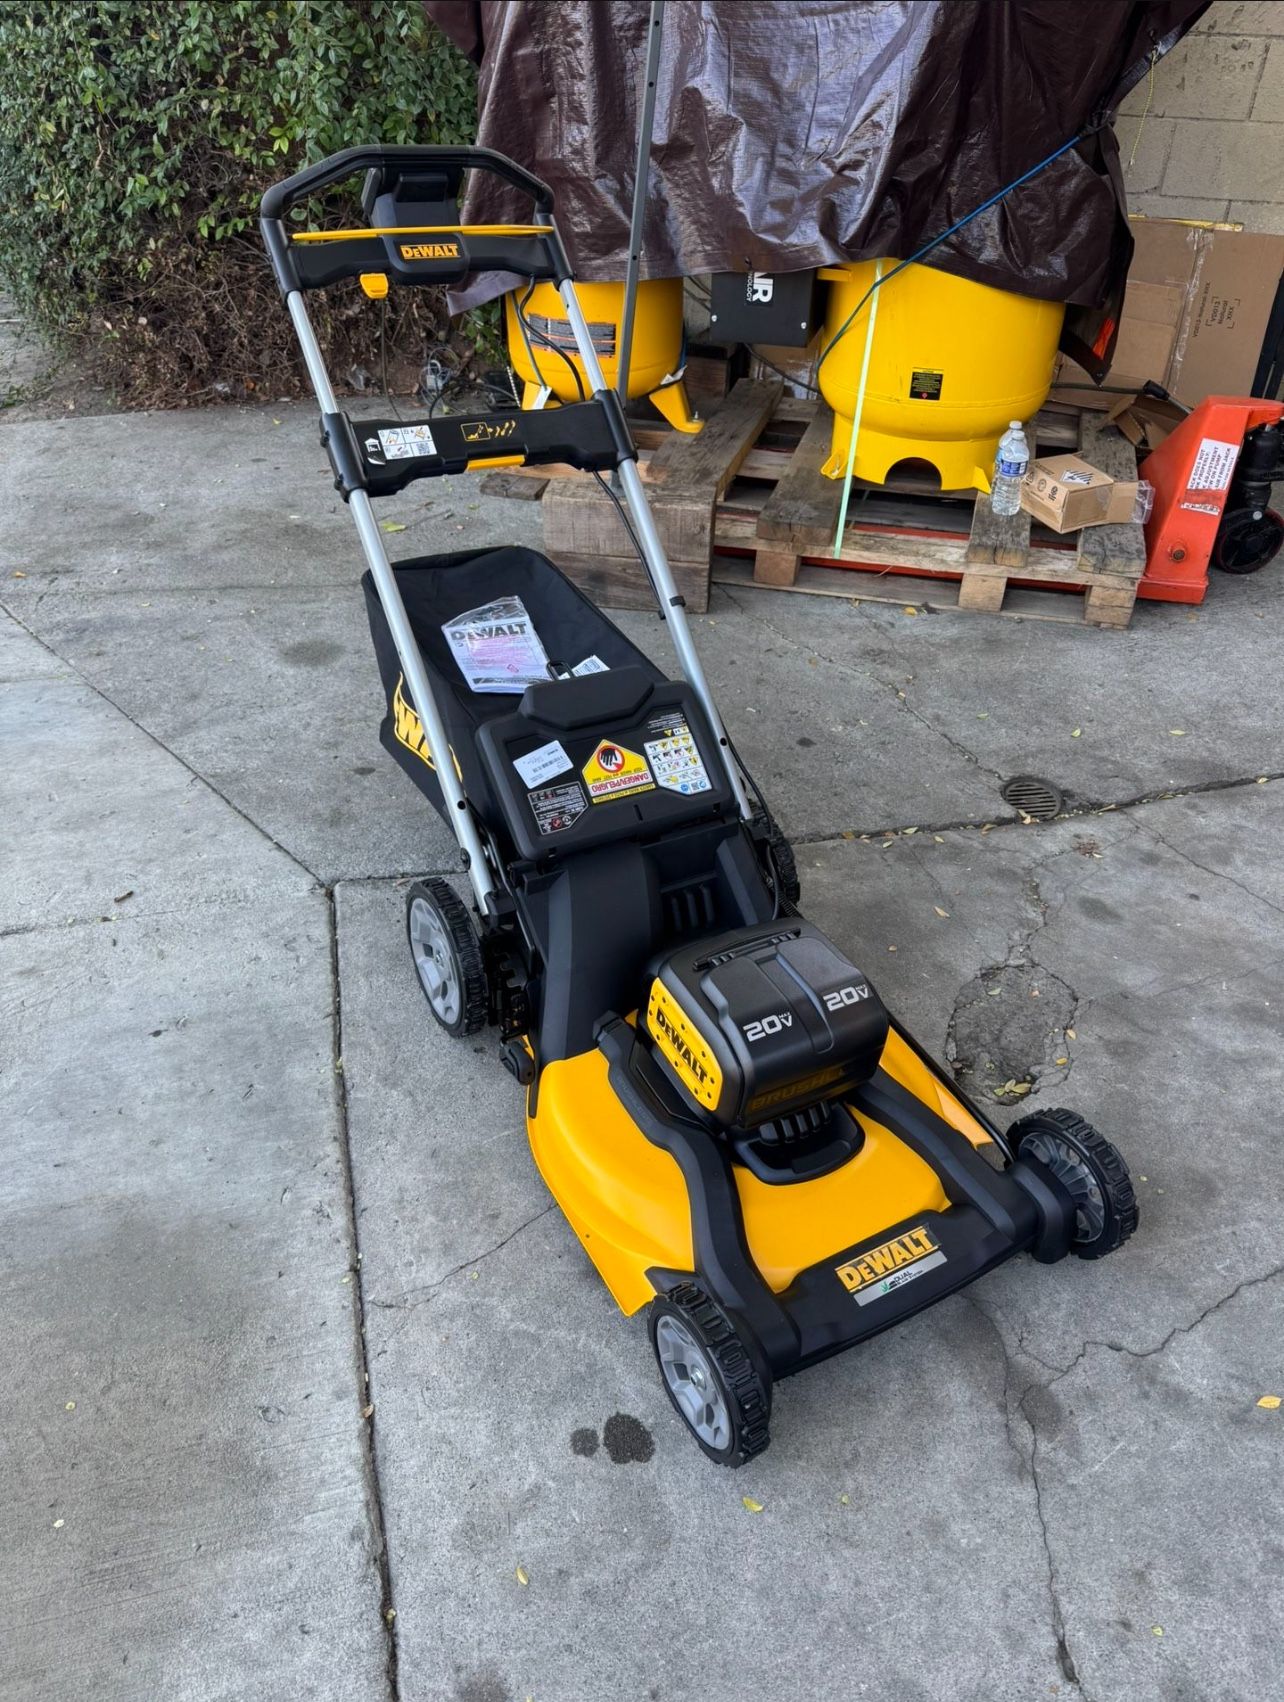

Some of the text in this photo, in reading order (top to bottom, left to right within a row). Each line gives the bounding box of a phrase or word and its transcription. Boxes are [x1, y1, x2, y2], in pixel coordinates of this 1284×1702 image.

[401, 245, 459, 258] DEWALT
[1204, 446, 1219, 484] ADJUSTMENT
[1211, 471, 1217, 480] ON
[592, 773, 649, 793] DANGER/PELIGRO
[656, 1006, 708, 1084] DEWALT
[836, 1228, 933, 1291] DEWALT
[893, 1271, 913, 1282] DUAL
